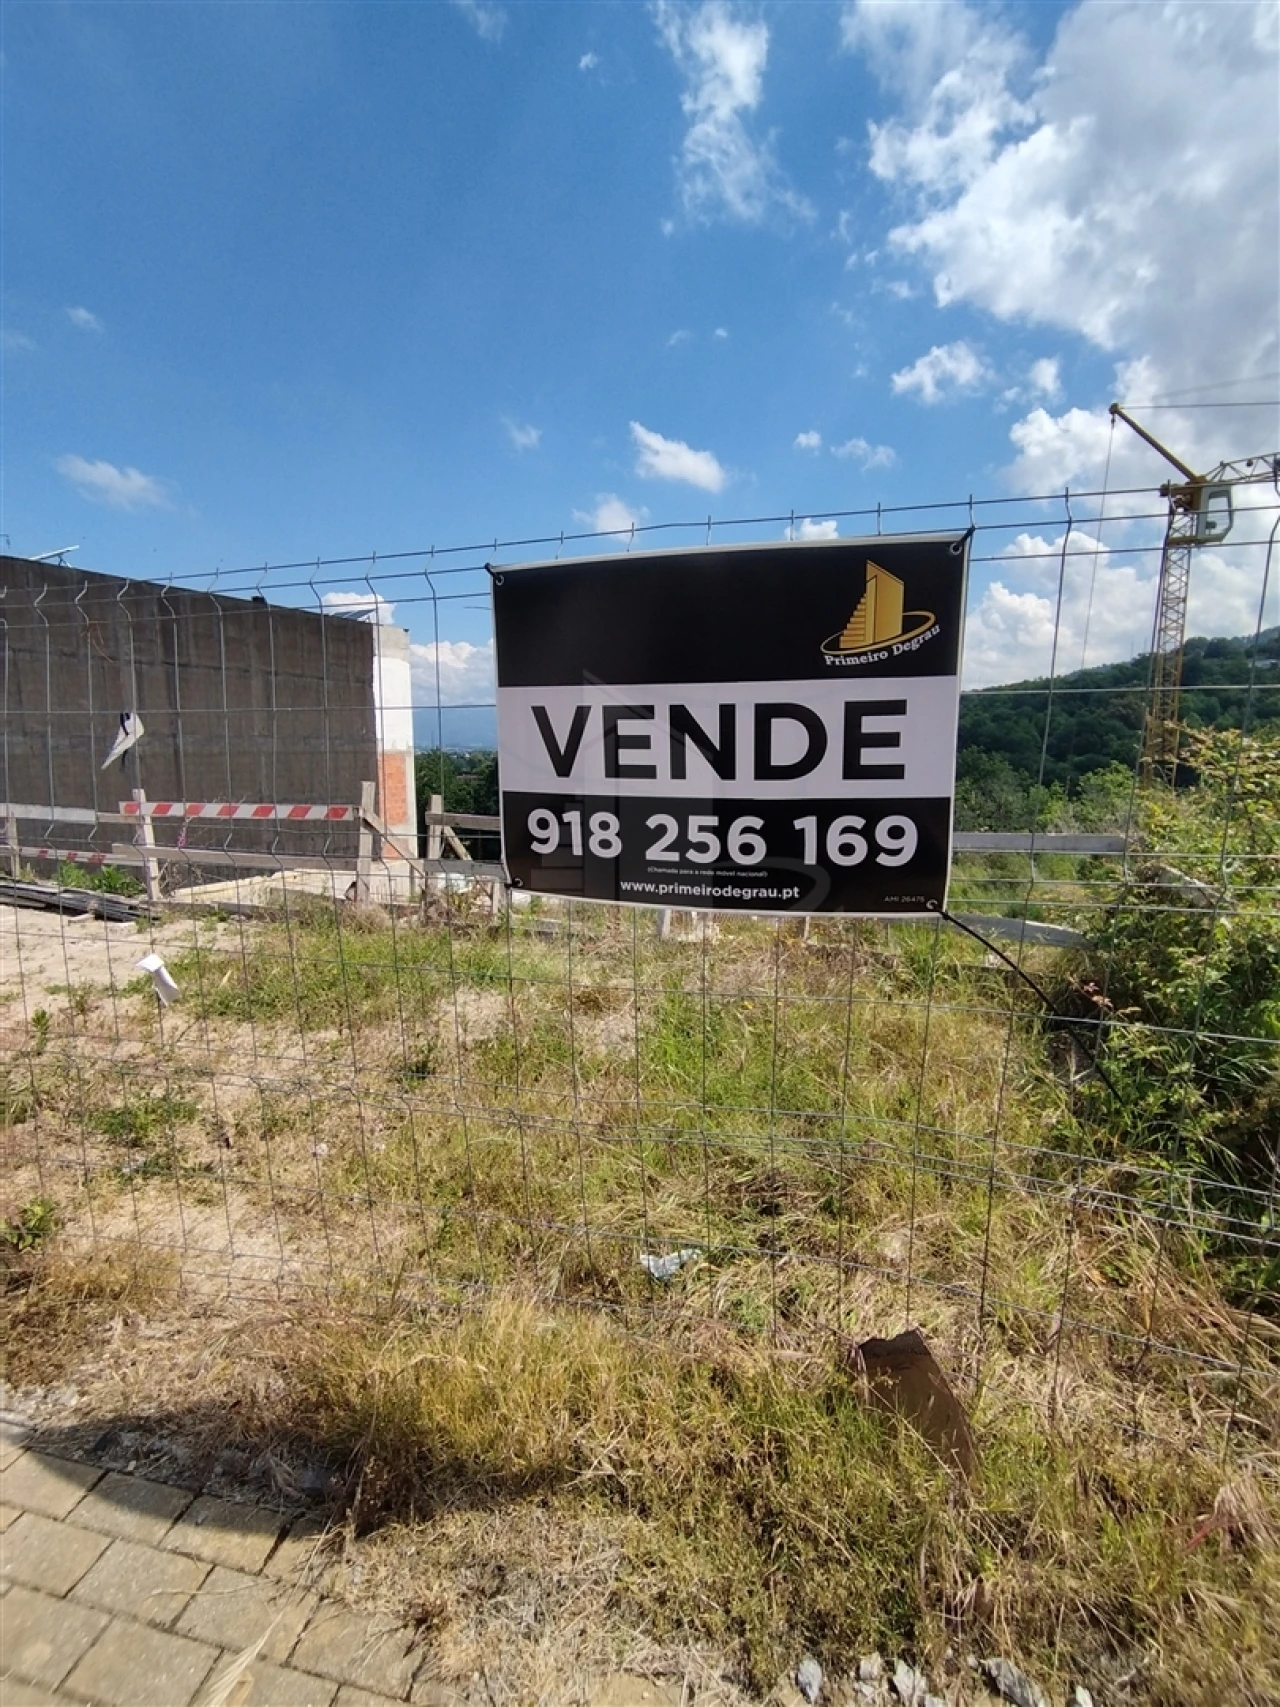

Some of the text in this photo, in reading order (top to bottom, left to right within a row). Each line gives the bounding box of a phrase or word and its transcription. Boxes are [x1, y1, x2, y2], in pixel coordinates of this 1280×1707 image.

[825, 625, 941, 666] Primeiro Degrau
[531, 700, 907, 781] VENDE
[527, 808, 918, 867] 918 256 169
[620, 880, 801, 900] www.primeirodegrau.pt
